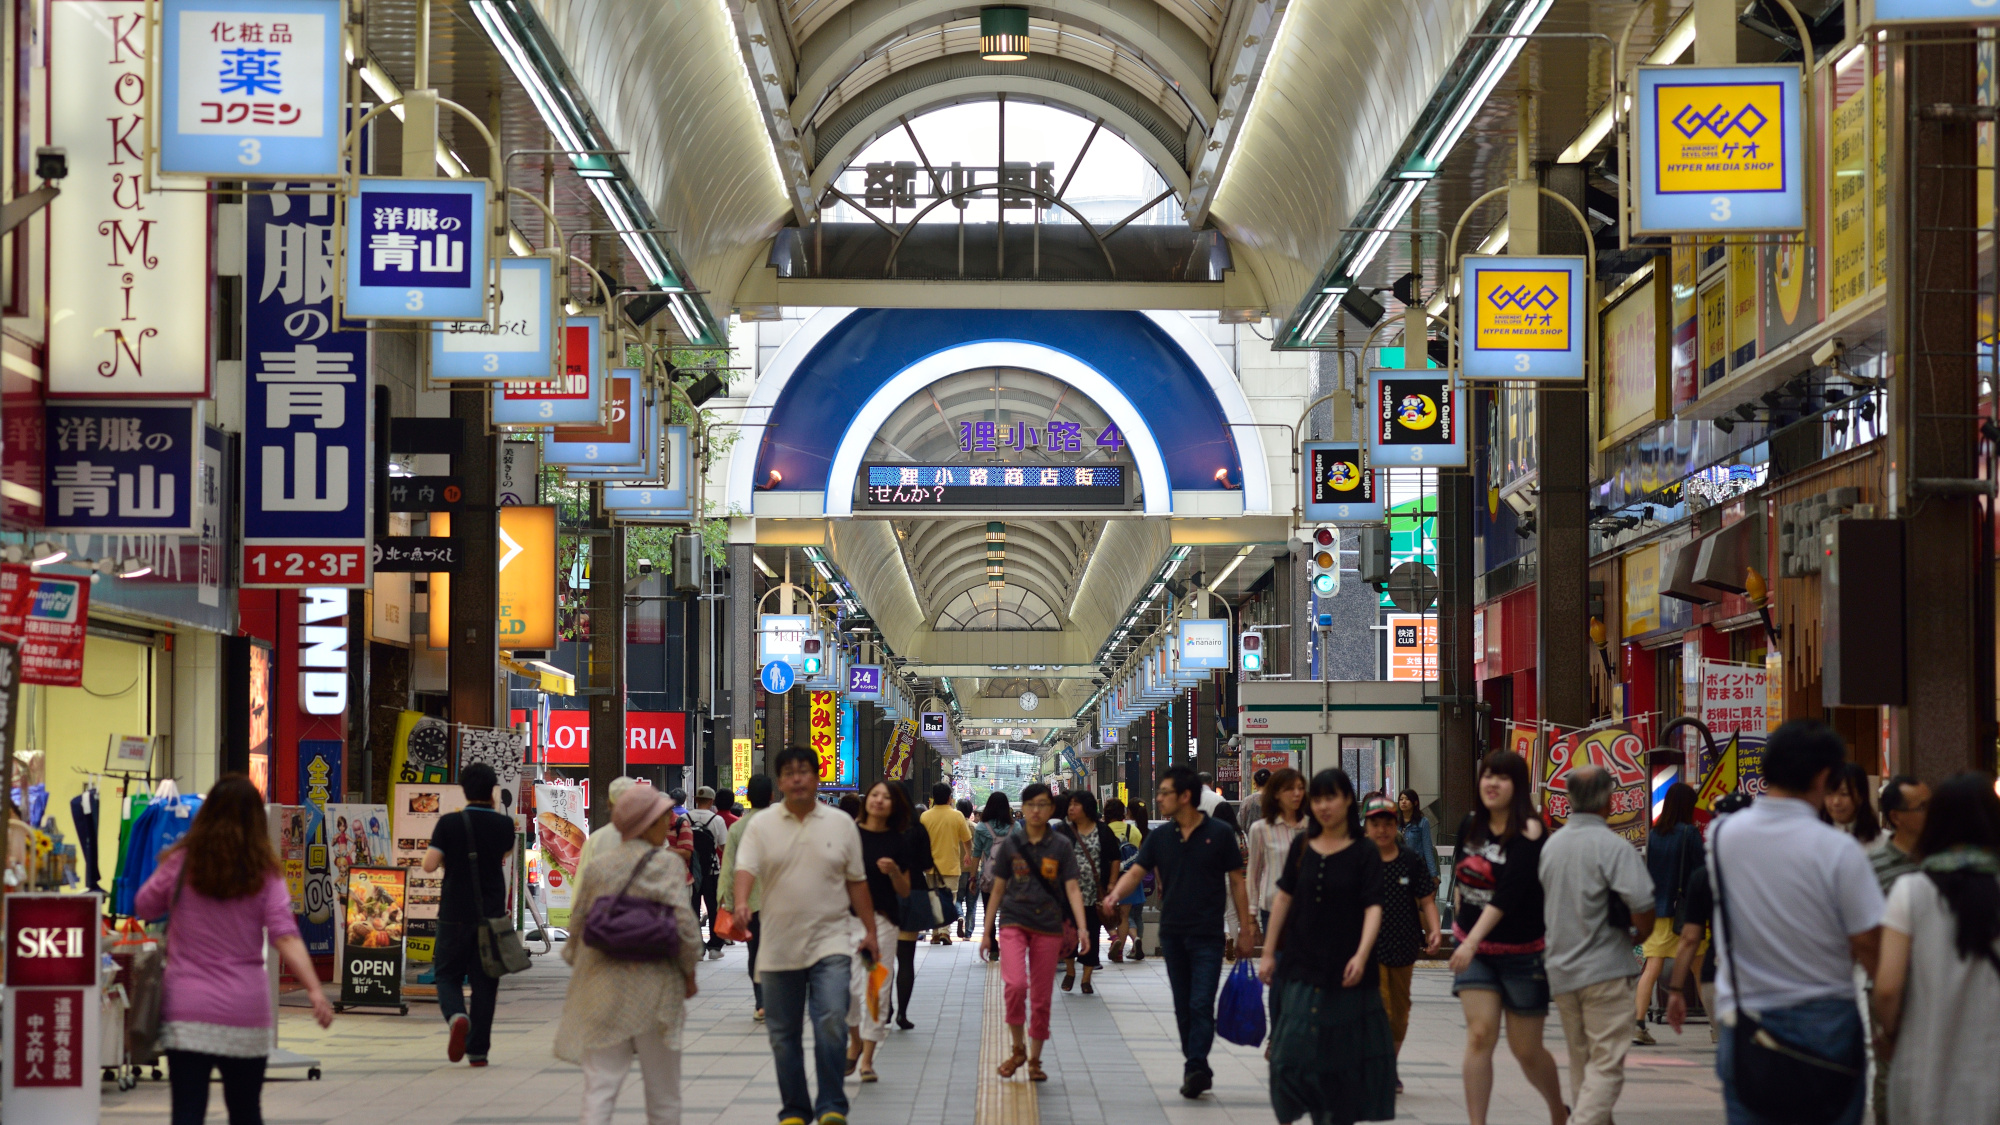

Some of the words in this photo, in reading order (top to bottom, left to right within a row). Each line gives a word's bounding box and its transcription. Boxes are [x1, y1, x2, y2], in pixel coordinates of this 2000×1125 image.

[211, 22, 292, 43] 化粧品
[219, 48, 283, 96] 薬
[200, 102, 302, 125] コクミン
[238, 138, 262, 166] 3
[1722, 142, 1760, 159] ゲオ
[1667, 163, 1702, 173] HYPER
[1705, 163, 1740, 172] MEDIA
[1743, 162, 1774, 171] SHOP
[1710, 197, 1732, 222] 3
[373, 207, 461, 231] 洋服の
[369, 231, 464, 273] 青山
[406, 290, 424, 312] 3
[1524, 313, 1552, 326] ゲオ
[483, 354, 499, 372] 3
[1515, 354, 1530, 371] 3
[539, 402, 554, 417] 3
[1442, 404, 1450, 439] Quijote
[58, 417, 173, 452] 洋服の
[959, 420, 1082, 453] 狸小路
[1095, 421, 1126, 453] 4
[585, 445, 598, 459] 3
[1411, 447, 1423, 462] 3
[899, 468, 1093, 486] 狸小路商店街
[52, 461, 175, 517] 青山
[391, 485, 435, 503] 竹内
[640, 491, 651, 504] 3
[1338, 505, 1349, 517] 3
[386, 547, 456, 562] 北の魚づくし
[1398, 629, 1414, 637] 快活
[1195, 638, 1222, 646] nanairo
[1707, 673, 1767, 687] ポイントが
[1707, 706, 1767, 720] お得に買え
[925, 723, 943, 731] Bar
[735, 743, 743, 781] 通行禁止
[350, 959, 394, 976] OPEN
[352, 977, 373, 985] 当ビル
[355, 986, 368, 994] B1F
[26, 1013, 44, 1080] 中文的人
